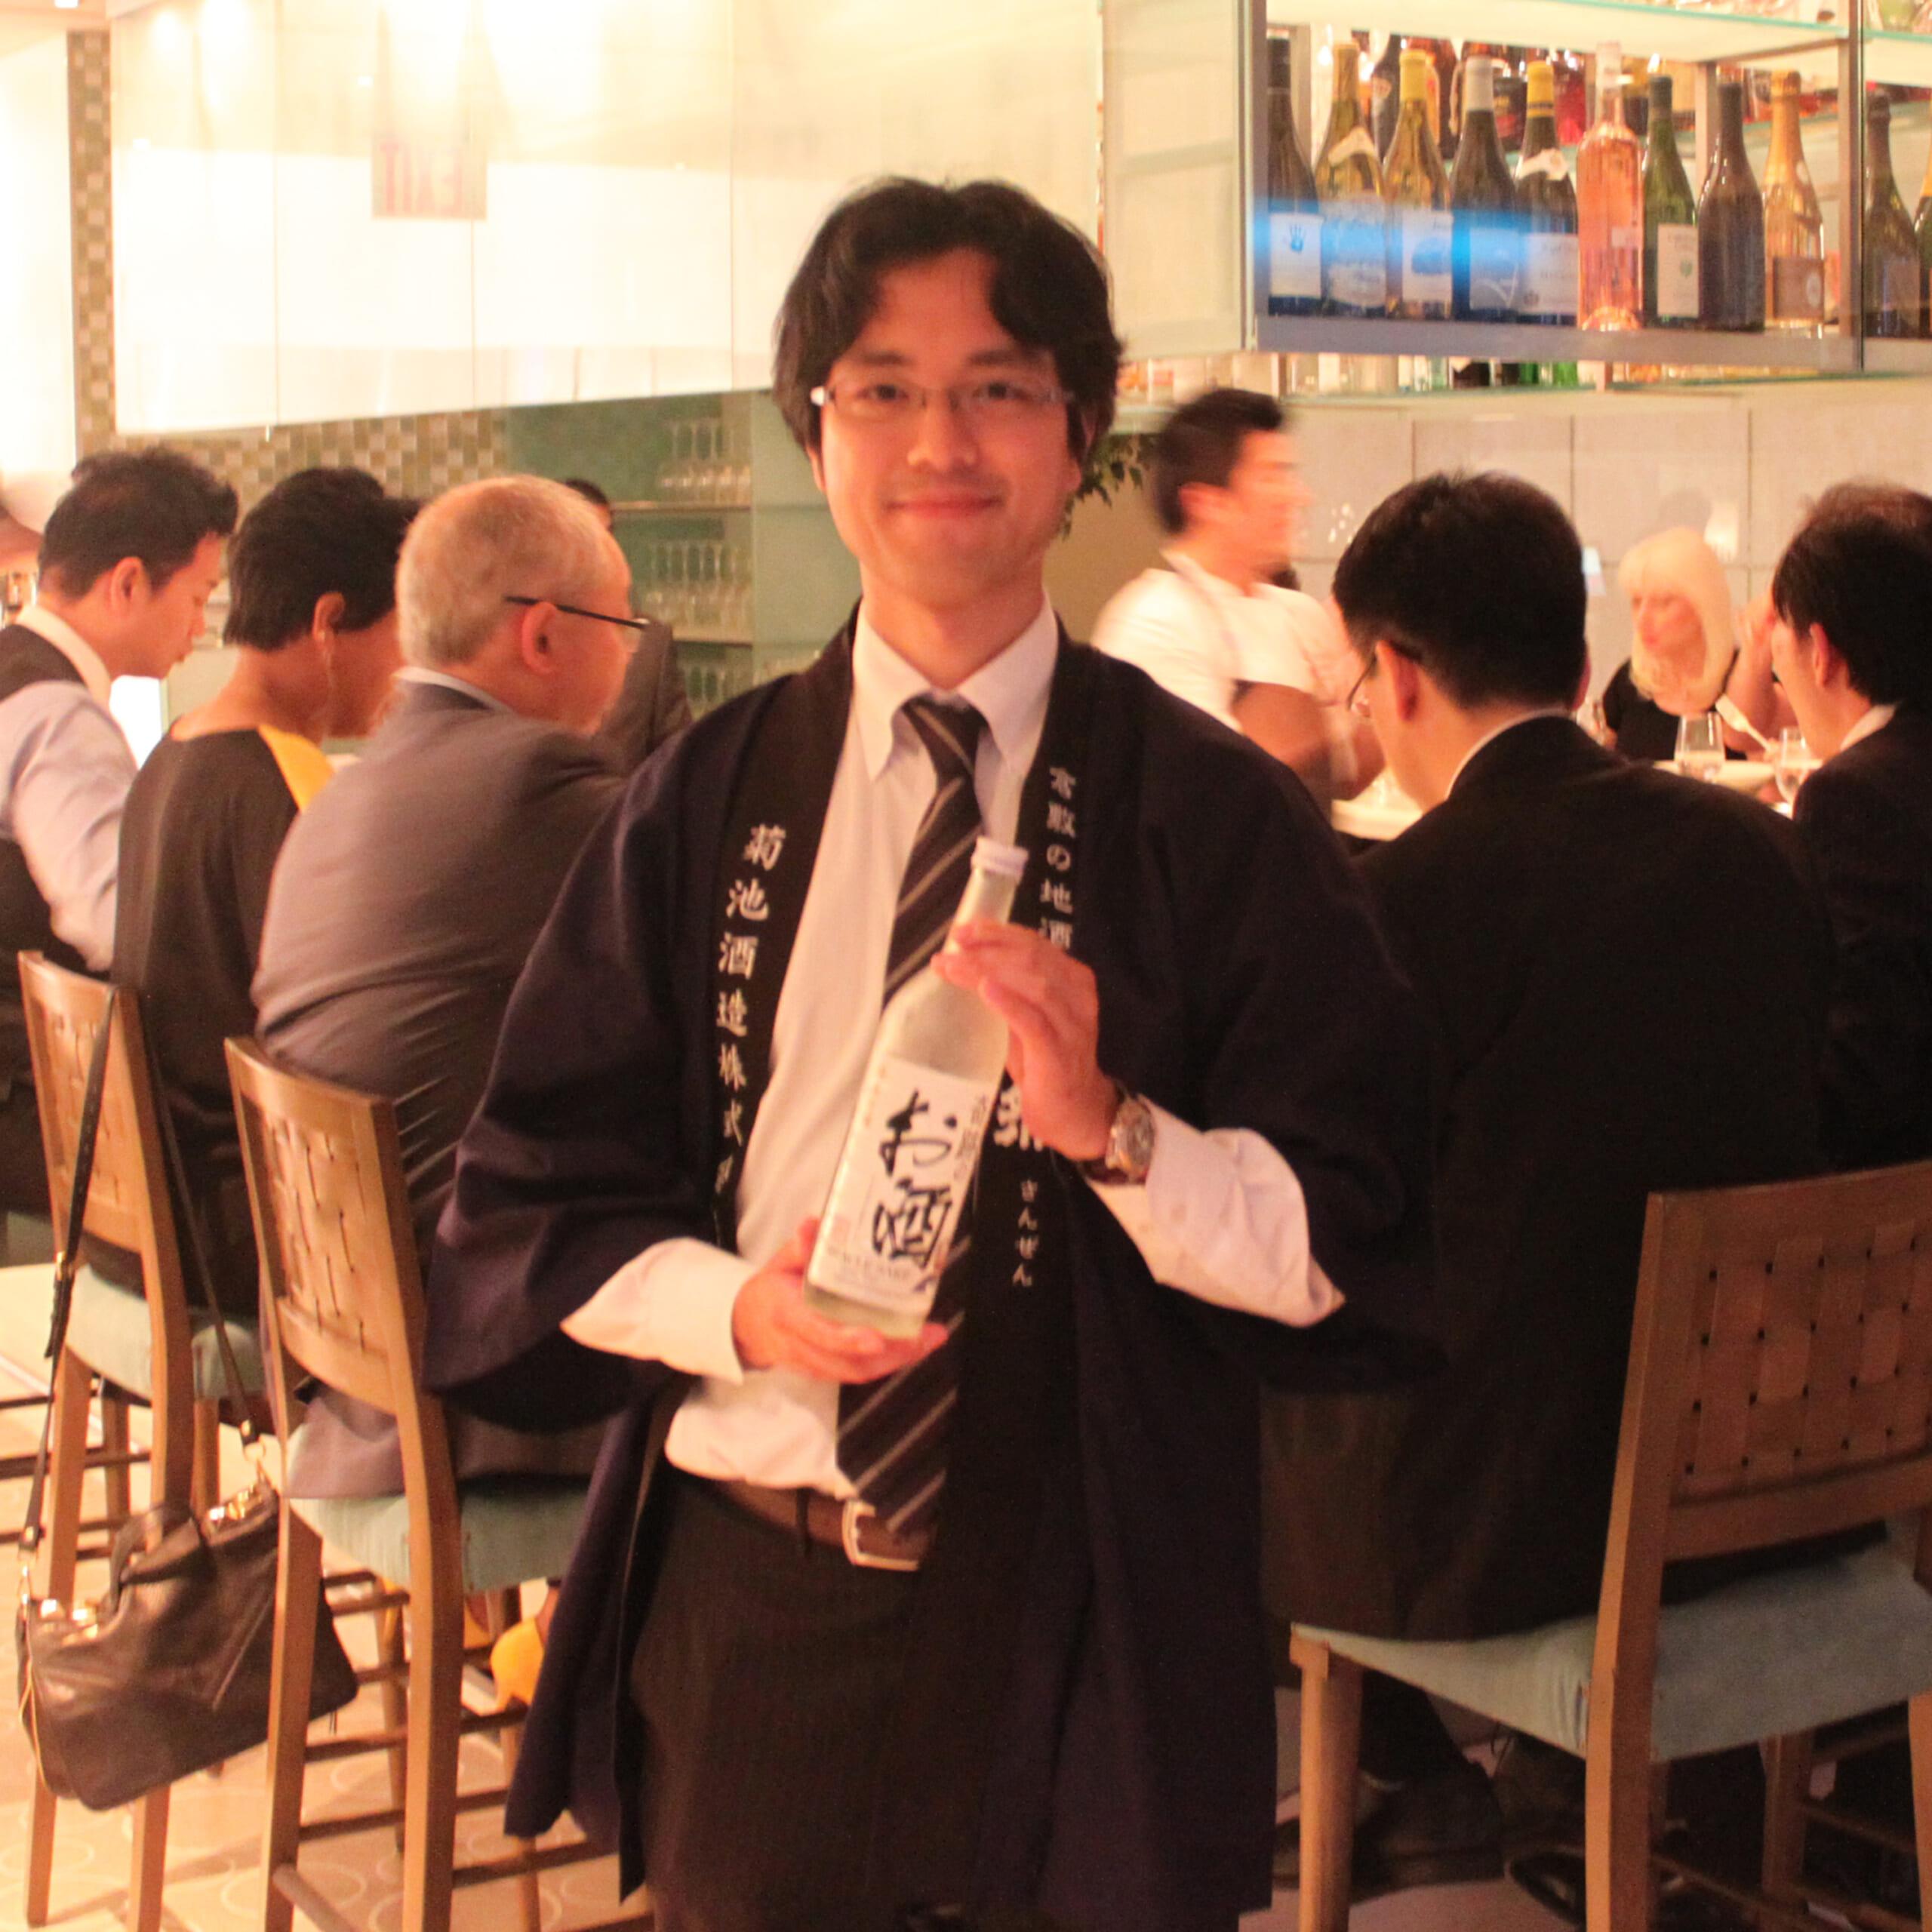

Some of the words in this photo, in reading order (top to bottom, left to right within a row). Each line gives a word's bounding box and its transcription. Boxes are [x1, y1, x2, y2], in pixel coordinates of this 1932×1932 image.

[713, 823, 786, 1245] 菊池酒造株式
